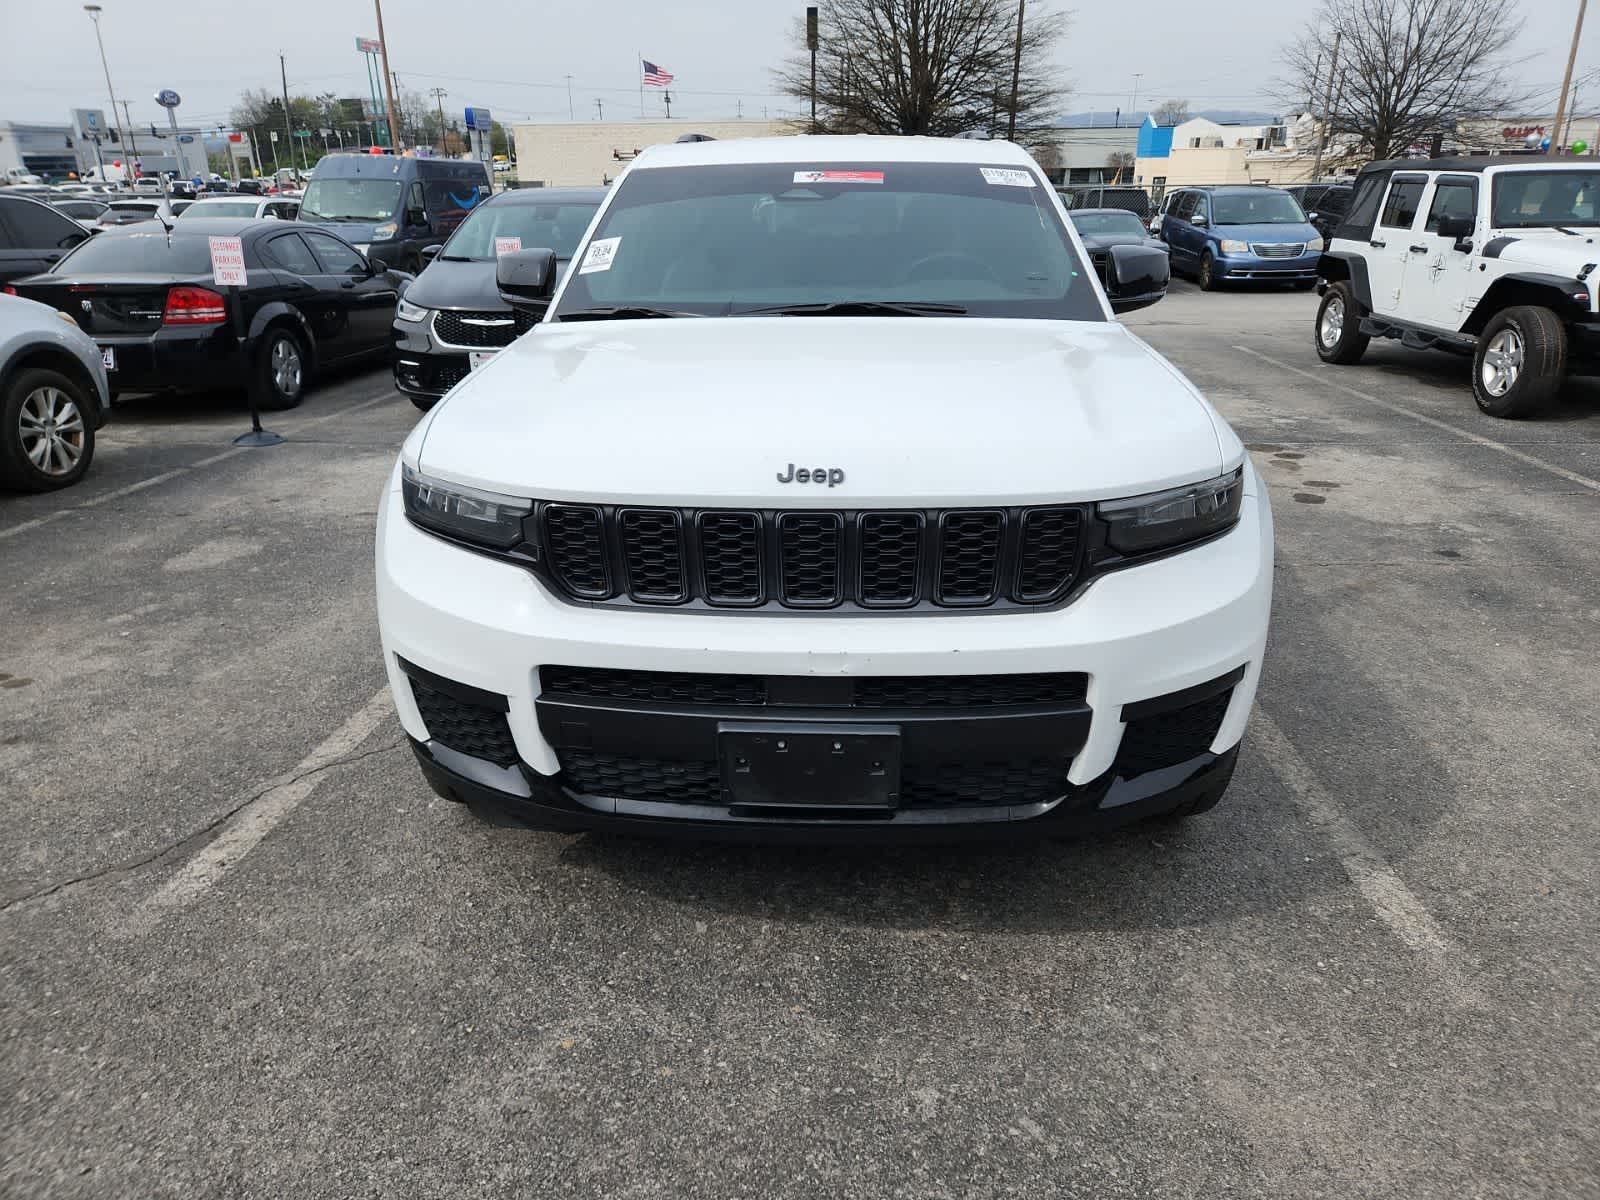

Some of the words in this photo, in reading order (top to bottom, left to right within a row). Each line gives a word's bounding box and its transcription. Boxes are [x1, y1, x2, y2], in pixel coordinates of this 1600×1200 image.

[214, 256, 242, 265] PARKING
[222, 272, 239, 281] ONLY
[776, 463, 845, 488] Jeep
